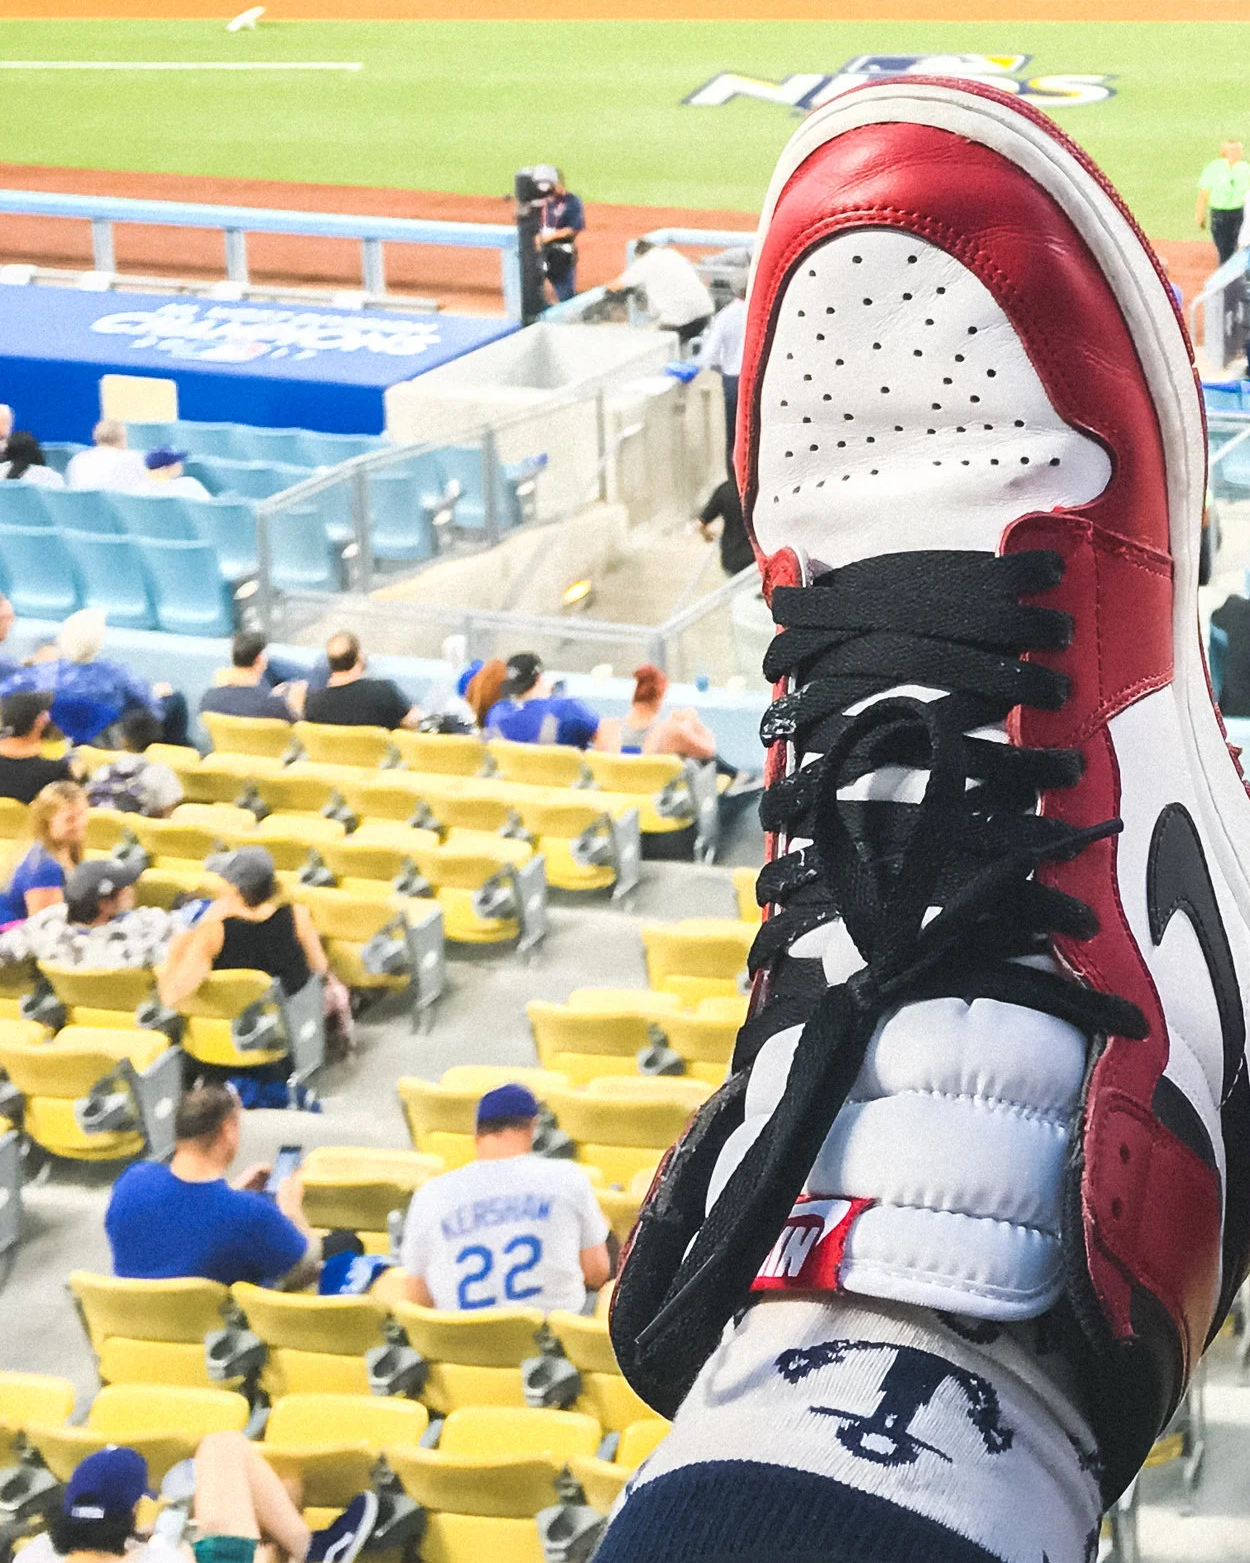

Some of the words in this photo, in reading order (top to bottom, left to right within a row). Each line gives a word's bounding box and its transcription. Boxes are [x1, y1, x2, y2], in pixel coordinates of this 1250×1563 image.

[682, 70, 1118, 115] NS
[456, 1234, 544, 1310] 22
[756, 1225, 820, 1277] NI
